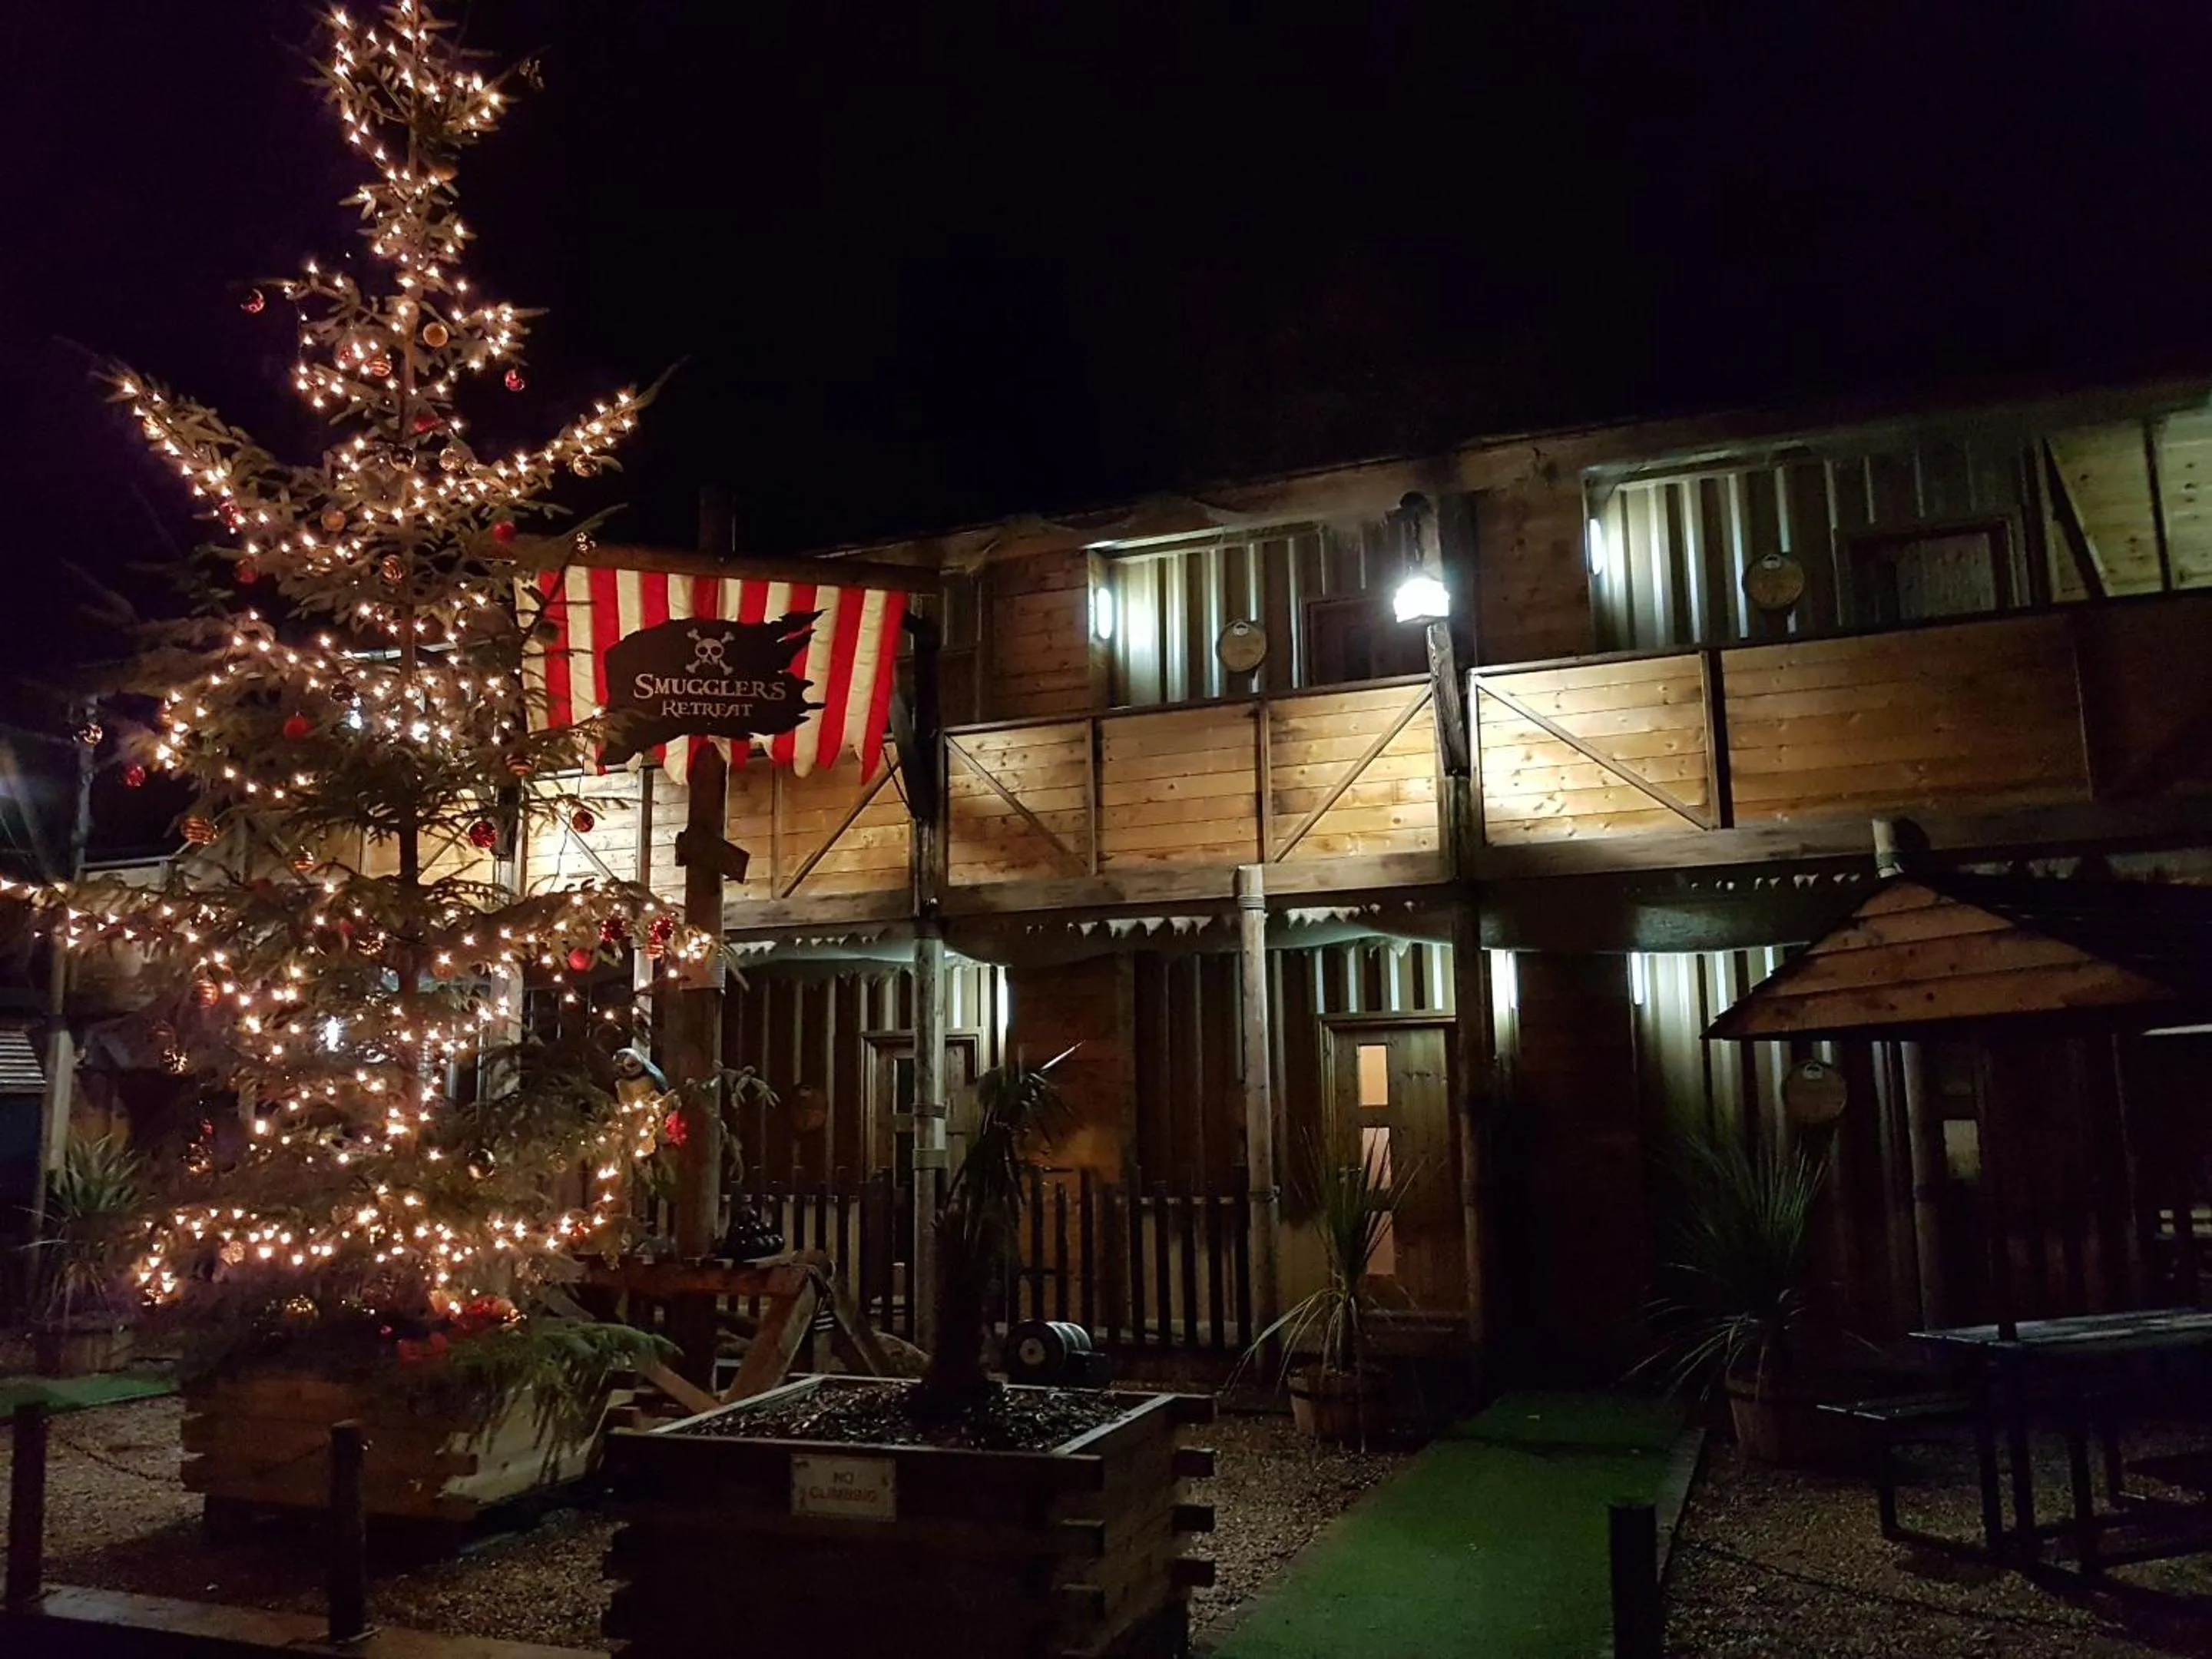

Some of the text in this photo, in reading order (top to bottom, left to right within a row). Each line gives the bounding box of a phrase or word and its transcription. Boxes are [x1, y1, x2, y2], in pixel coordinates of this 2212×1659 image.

[634, 674, 786, 700] SMUGGLERS
[661, 700, 753, 718] RETREAT
[833, 1472, 855, 1485] NO
